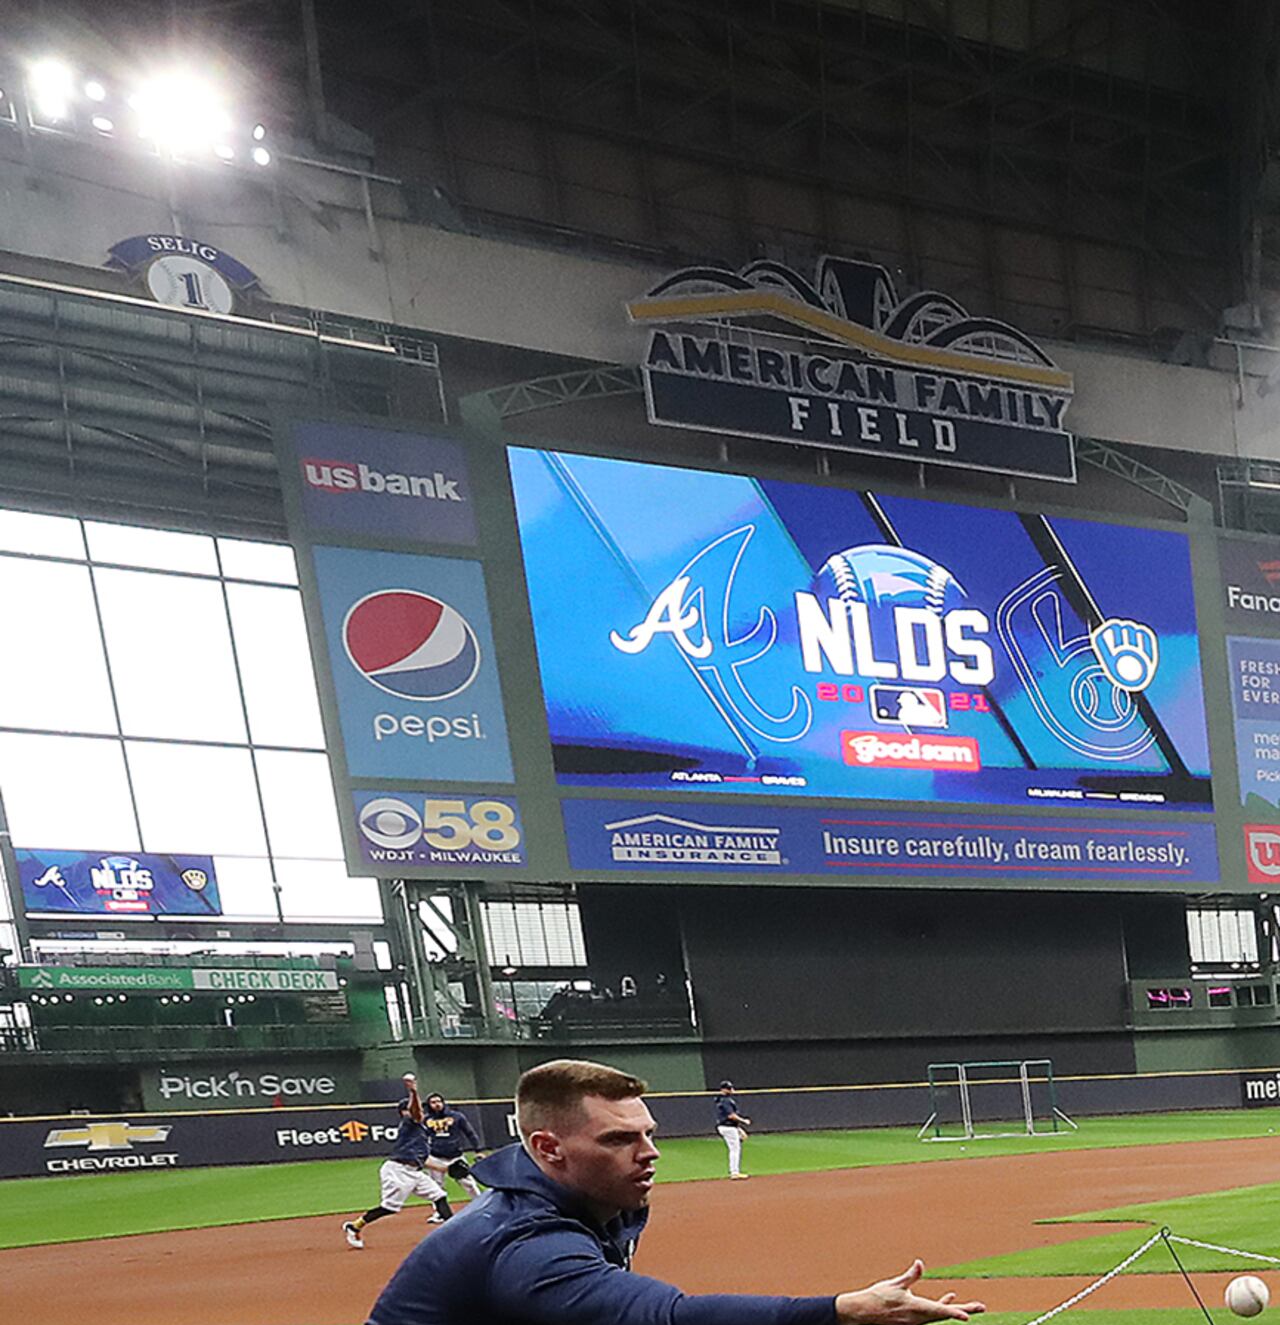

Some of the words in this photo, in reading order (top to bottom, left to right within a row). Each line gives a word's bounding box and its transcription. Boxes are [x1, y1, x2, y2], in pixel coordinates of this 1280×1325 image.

[147, 234, 217, 262] SELIG
[179, 270, 207, 310] 1
[648, 331, 898, 403] AMERICAN
[916, 374, 1067, 431] FAMILY
[789, 398, 956, 453] FIELD
[795, 591, 996, 687] NLDS
[1242, 676, 1270, 690] FOR
[816, 683, 865, 703] 20
[948, 691, 990, 713] 21
[374, 712, 481, 744] pepsi
[424, 800, 519, 852] 58
[611, 832, 710, 850] AMERICAN
[713, 833, 781, 851] FAMILY
[823, 831, 900, 857] Insure
[906, 834, 1010, 863] carefully,
[1014, 837, 1080, 861] dream
[1085, 839, 1191, 866] fearlessly.
[370, 850, 415, 862] WDJT
[430, 850, 522, 864] MILWAUKEE
[626, 848, 766, 862] INSURANCE
[91, 867, 154, 890] NLDS
[210, 972, 272, 989] CHECK
[278, 971, 327, 989] DECK
[259, 1074, 336, 1096] Save
[277, 1128, 340, 1147] Fleet
[46, 1153, 179, 1172] CHEVROLET
